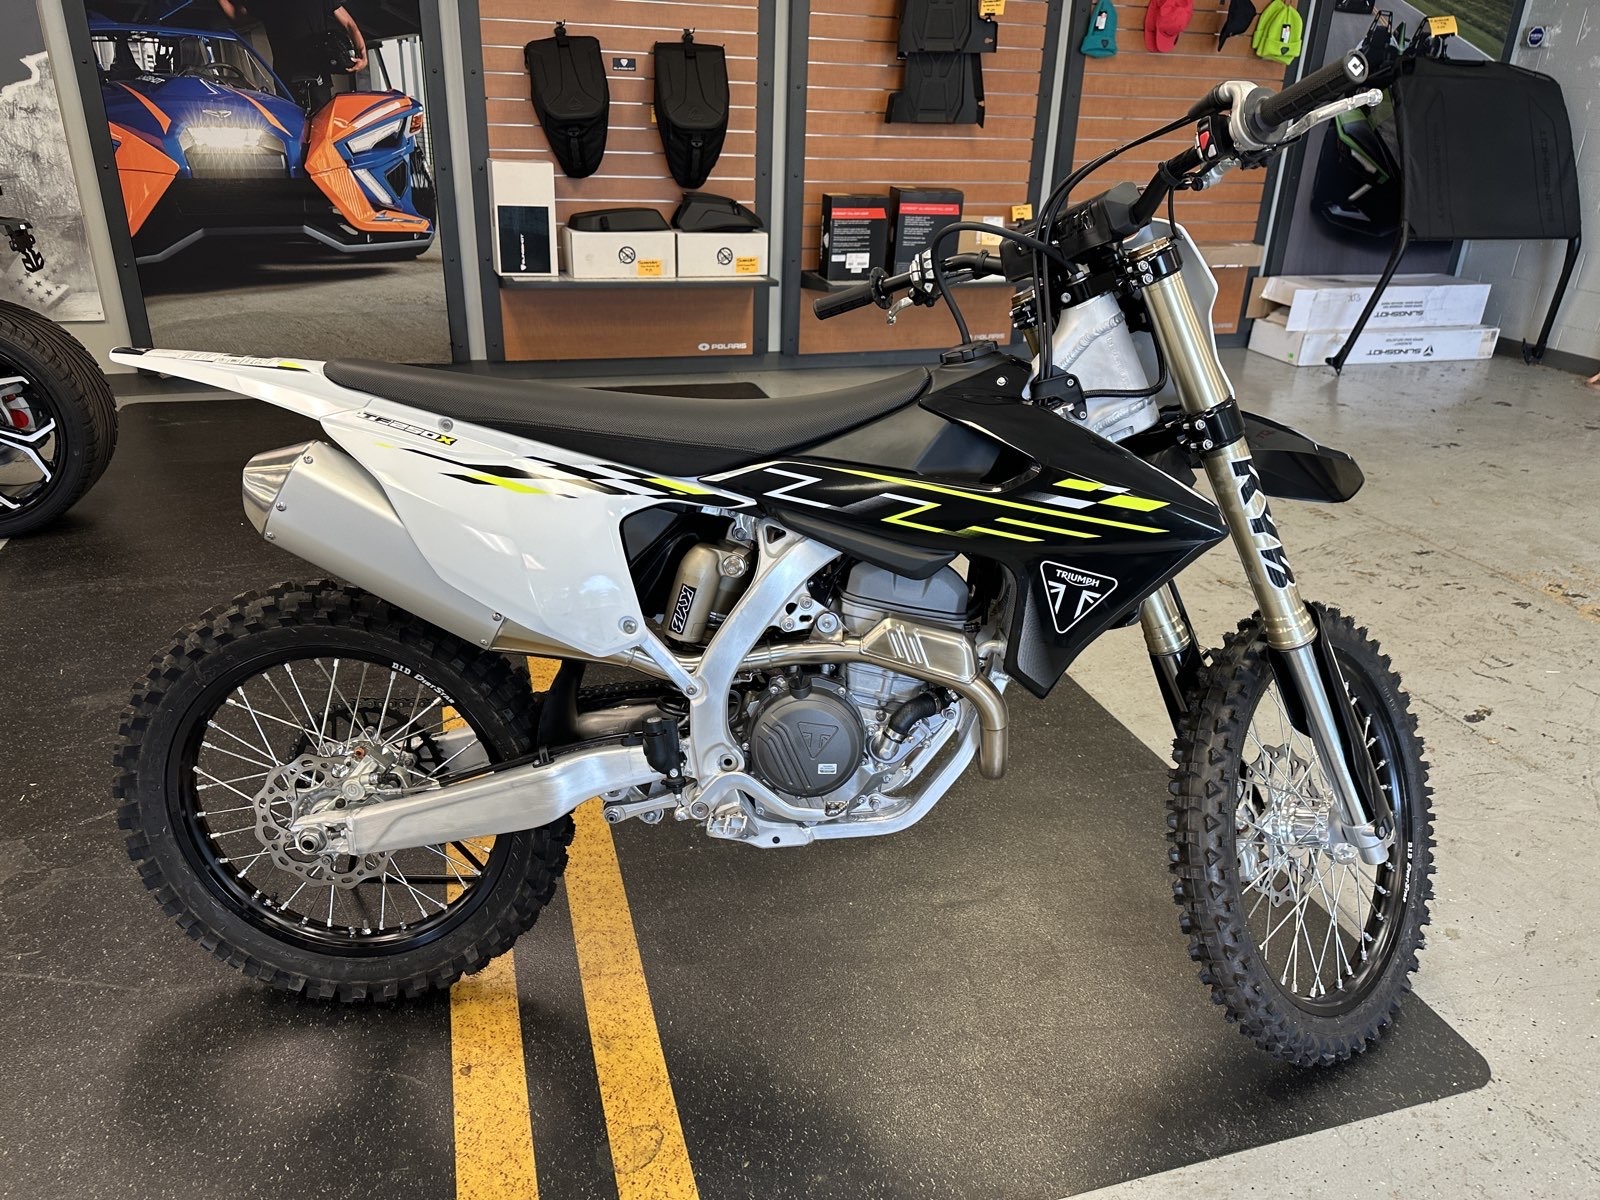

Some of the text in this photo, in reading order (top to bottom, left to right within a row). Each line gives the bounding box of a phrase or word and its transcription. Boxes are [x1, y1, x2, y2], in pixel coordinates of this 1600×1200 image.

[1374, 310, 1424, 318] SLINGSHOT
[1366, 348, 1422, 356] SLINGSHOT
[1227, 455, 1297, 591] KYB
[1056, 569, 1100, 588] TRIUMPH
[671, 585, 694, 633] KYB
